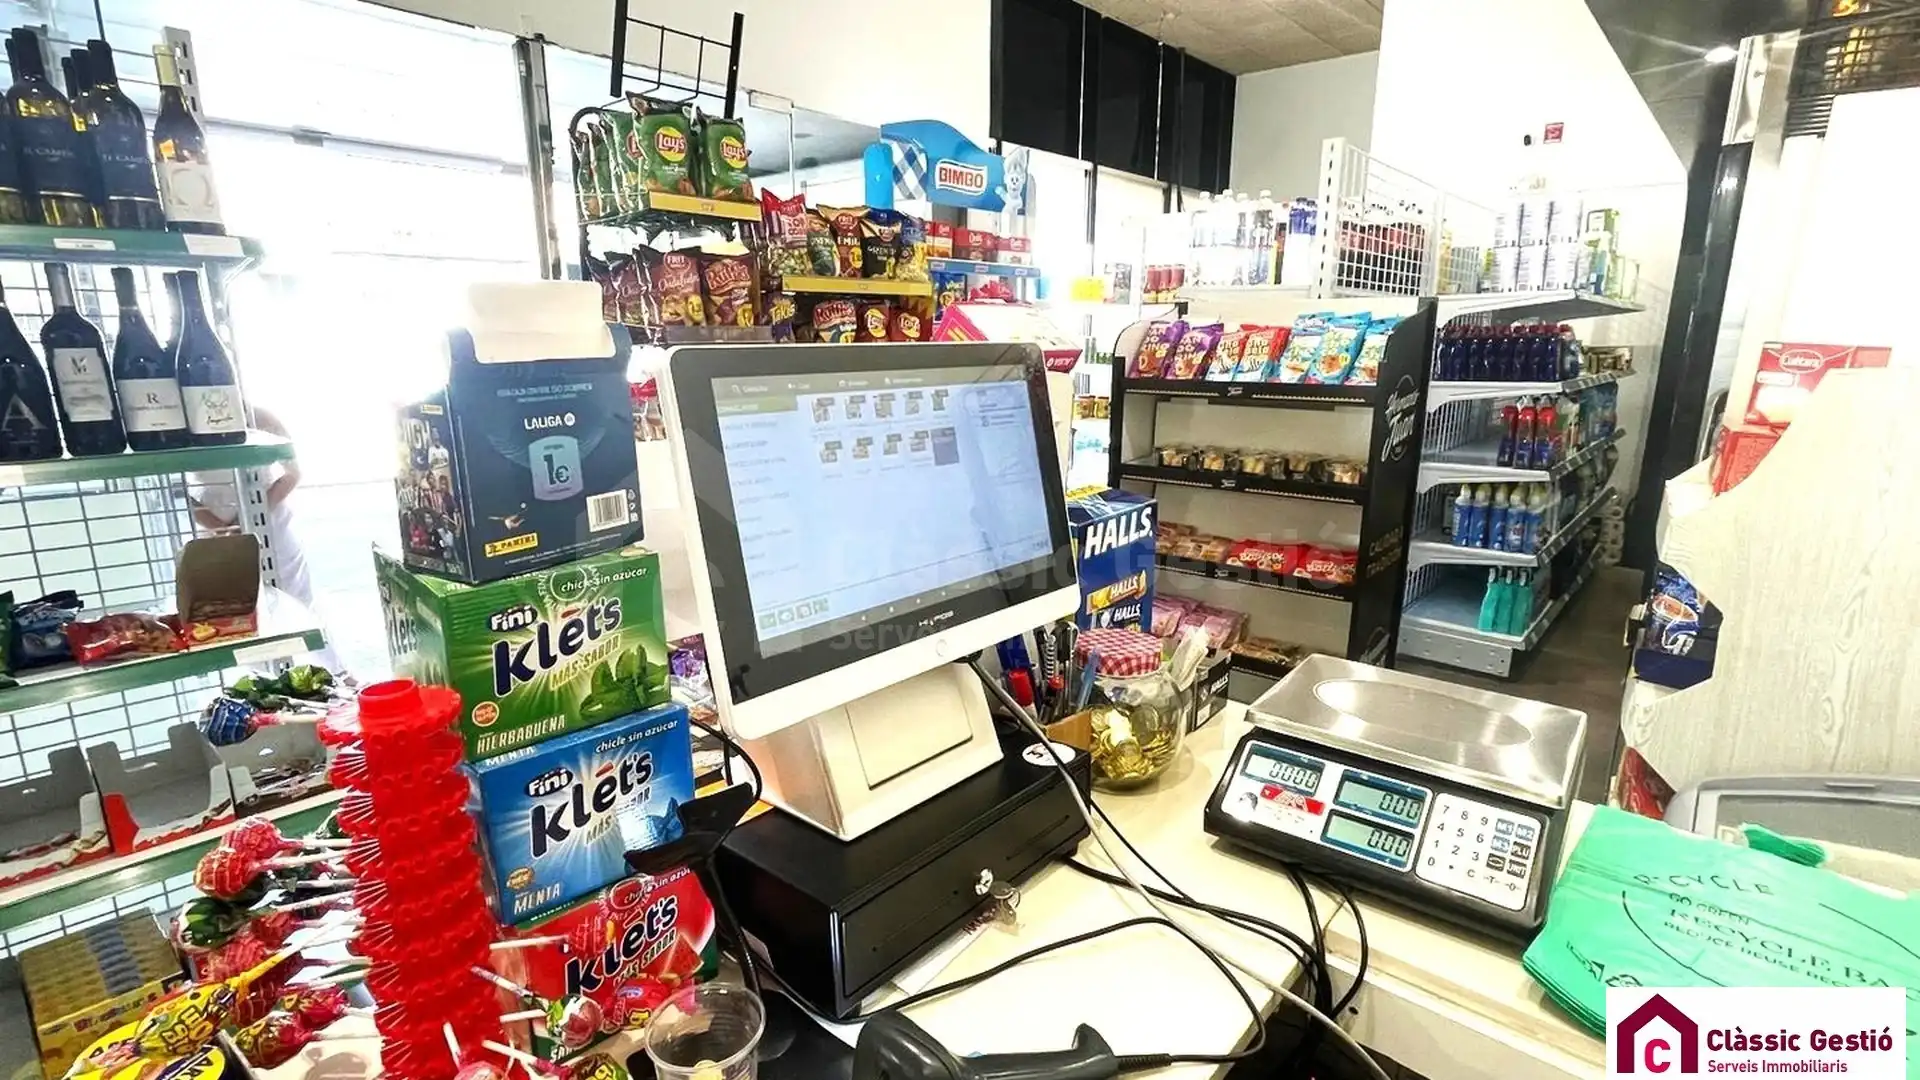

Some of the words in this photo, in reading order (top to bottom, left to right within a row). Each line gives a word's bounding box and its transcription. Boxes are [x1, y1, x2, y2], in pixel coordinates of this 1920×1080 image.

[939, 166, 984, 190] BIMBO
[524, 415, 563, 430] LALIGA
[500, 535, 537, 550] PANINI
[1084, 506, 1153, 560] HALLS
[612, 567, 648, 581] azúcar
[1110, 575, 1139, 599] HALLS
[490, 605, 533, 632] Fini
[1114, 603, 1141, 622] HALLS
[476, 714, 565, 755] HIERBABUENA
[595, 735, 626, 754] chicle
[627, 730, 643, 744] sin
[645, 719, 679, 739] azúcar
[528, 768, 569, 797] Fini
[1461, 811, 1469, 820] 8
[1480, 816, 1489, 826] 9
[1437, 822, 1445, 831] 4
[1456, 828, 1465, 837] 5
[1476, 833, 1485, 843] 6
[1451, 845, 1460, 855] 2
[1472, 851, 1480, 861] 3
[1427, 856, 1436, 866] 0
[1467, 869, 1476, 878] C
[514, 882, 560, 915] MENTA
[1669, 892, 1692, 906] GO
[1696, 902, 1750, 926] GREEN
